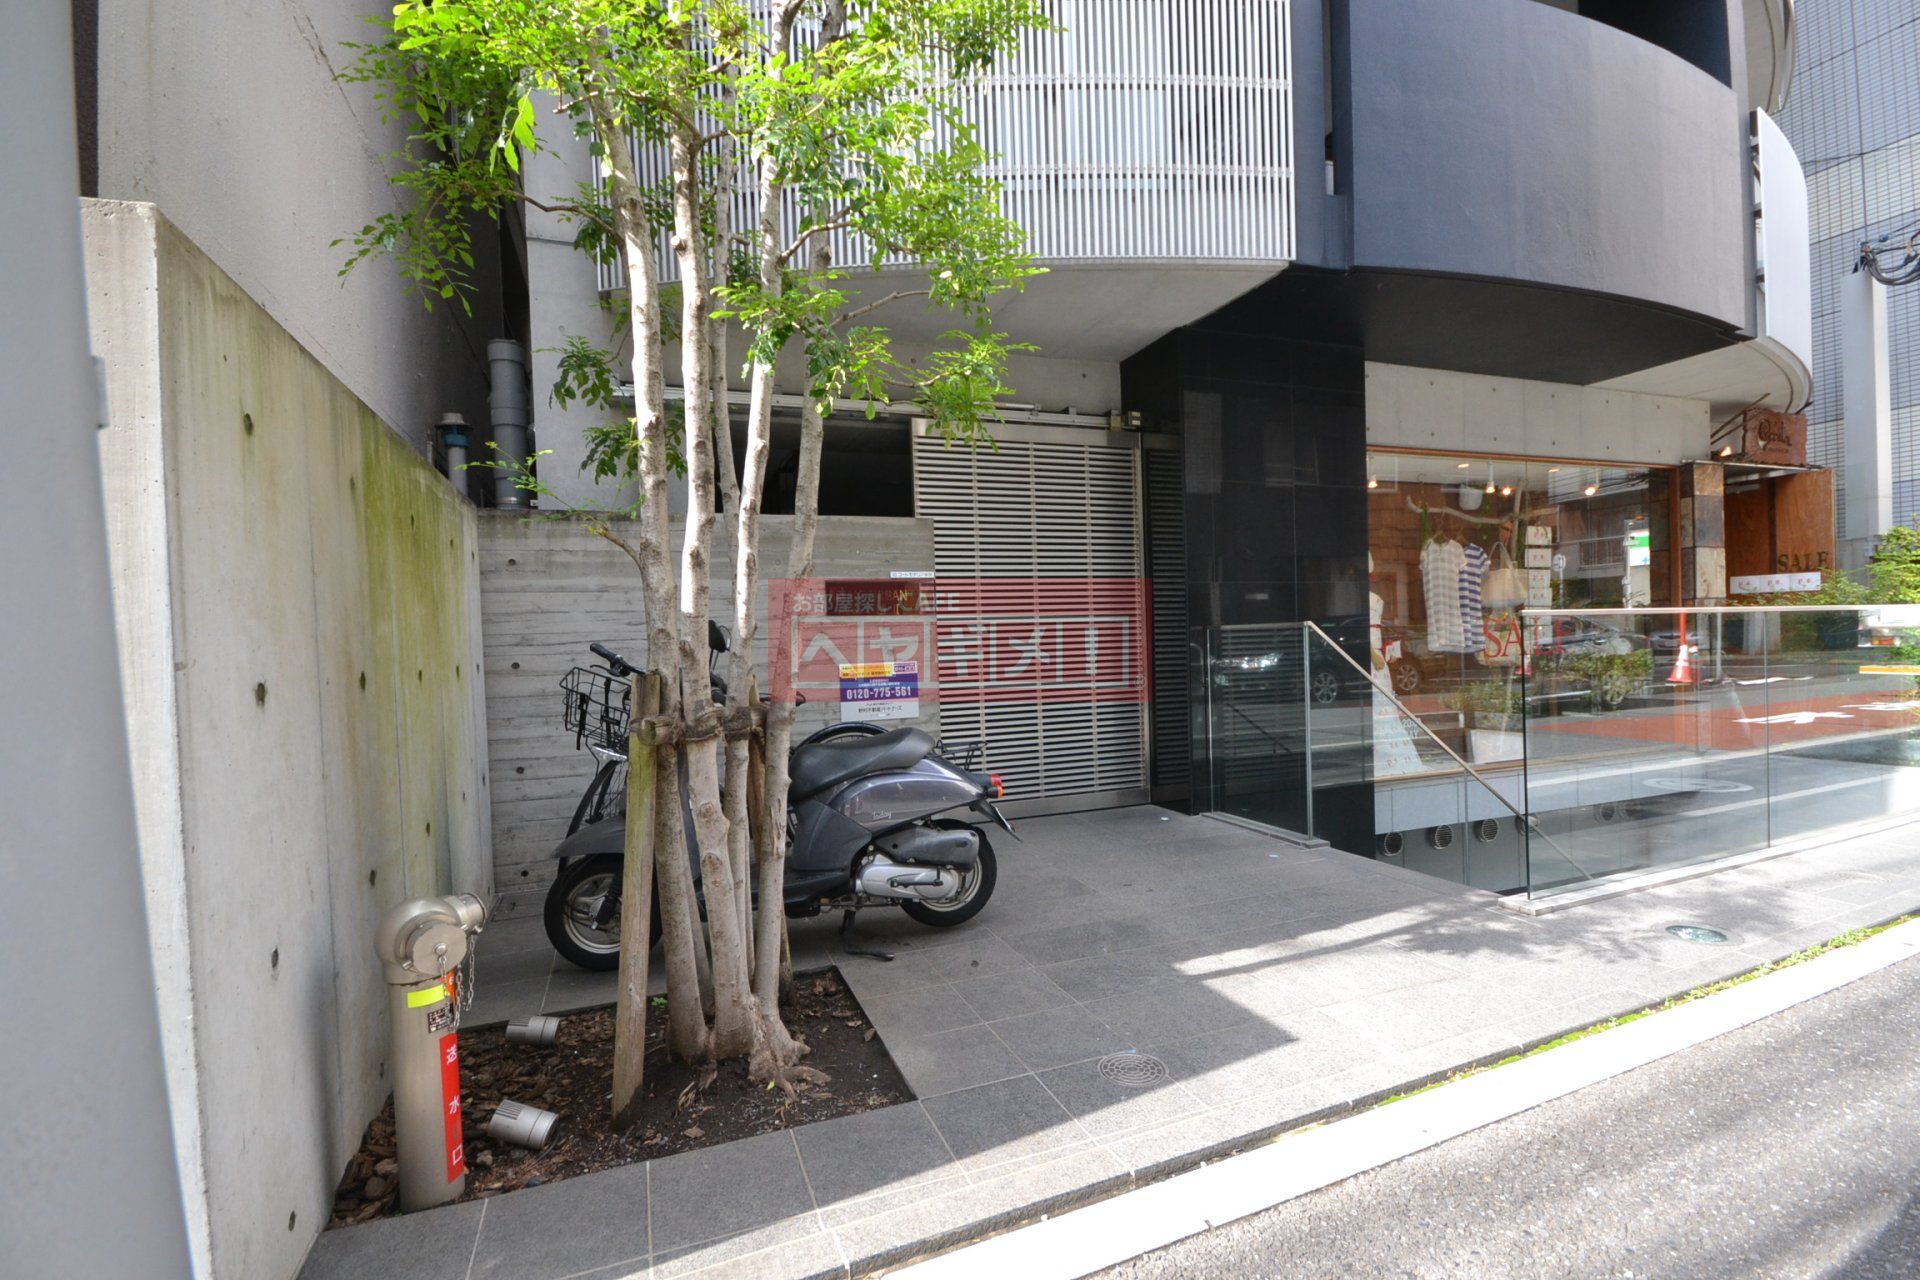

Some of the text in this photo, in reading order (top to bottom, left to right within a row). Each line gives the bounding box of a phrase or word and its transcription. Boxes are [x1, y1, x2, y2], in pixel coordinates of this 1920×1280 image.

[846, 686, 912, 700] 0120-775-561
[446, 1043, 463, 1166] 送水口
